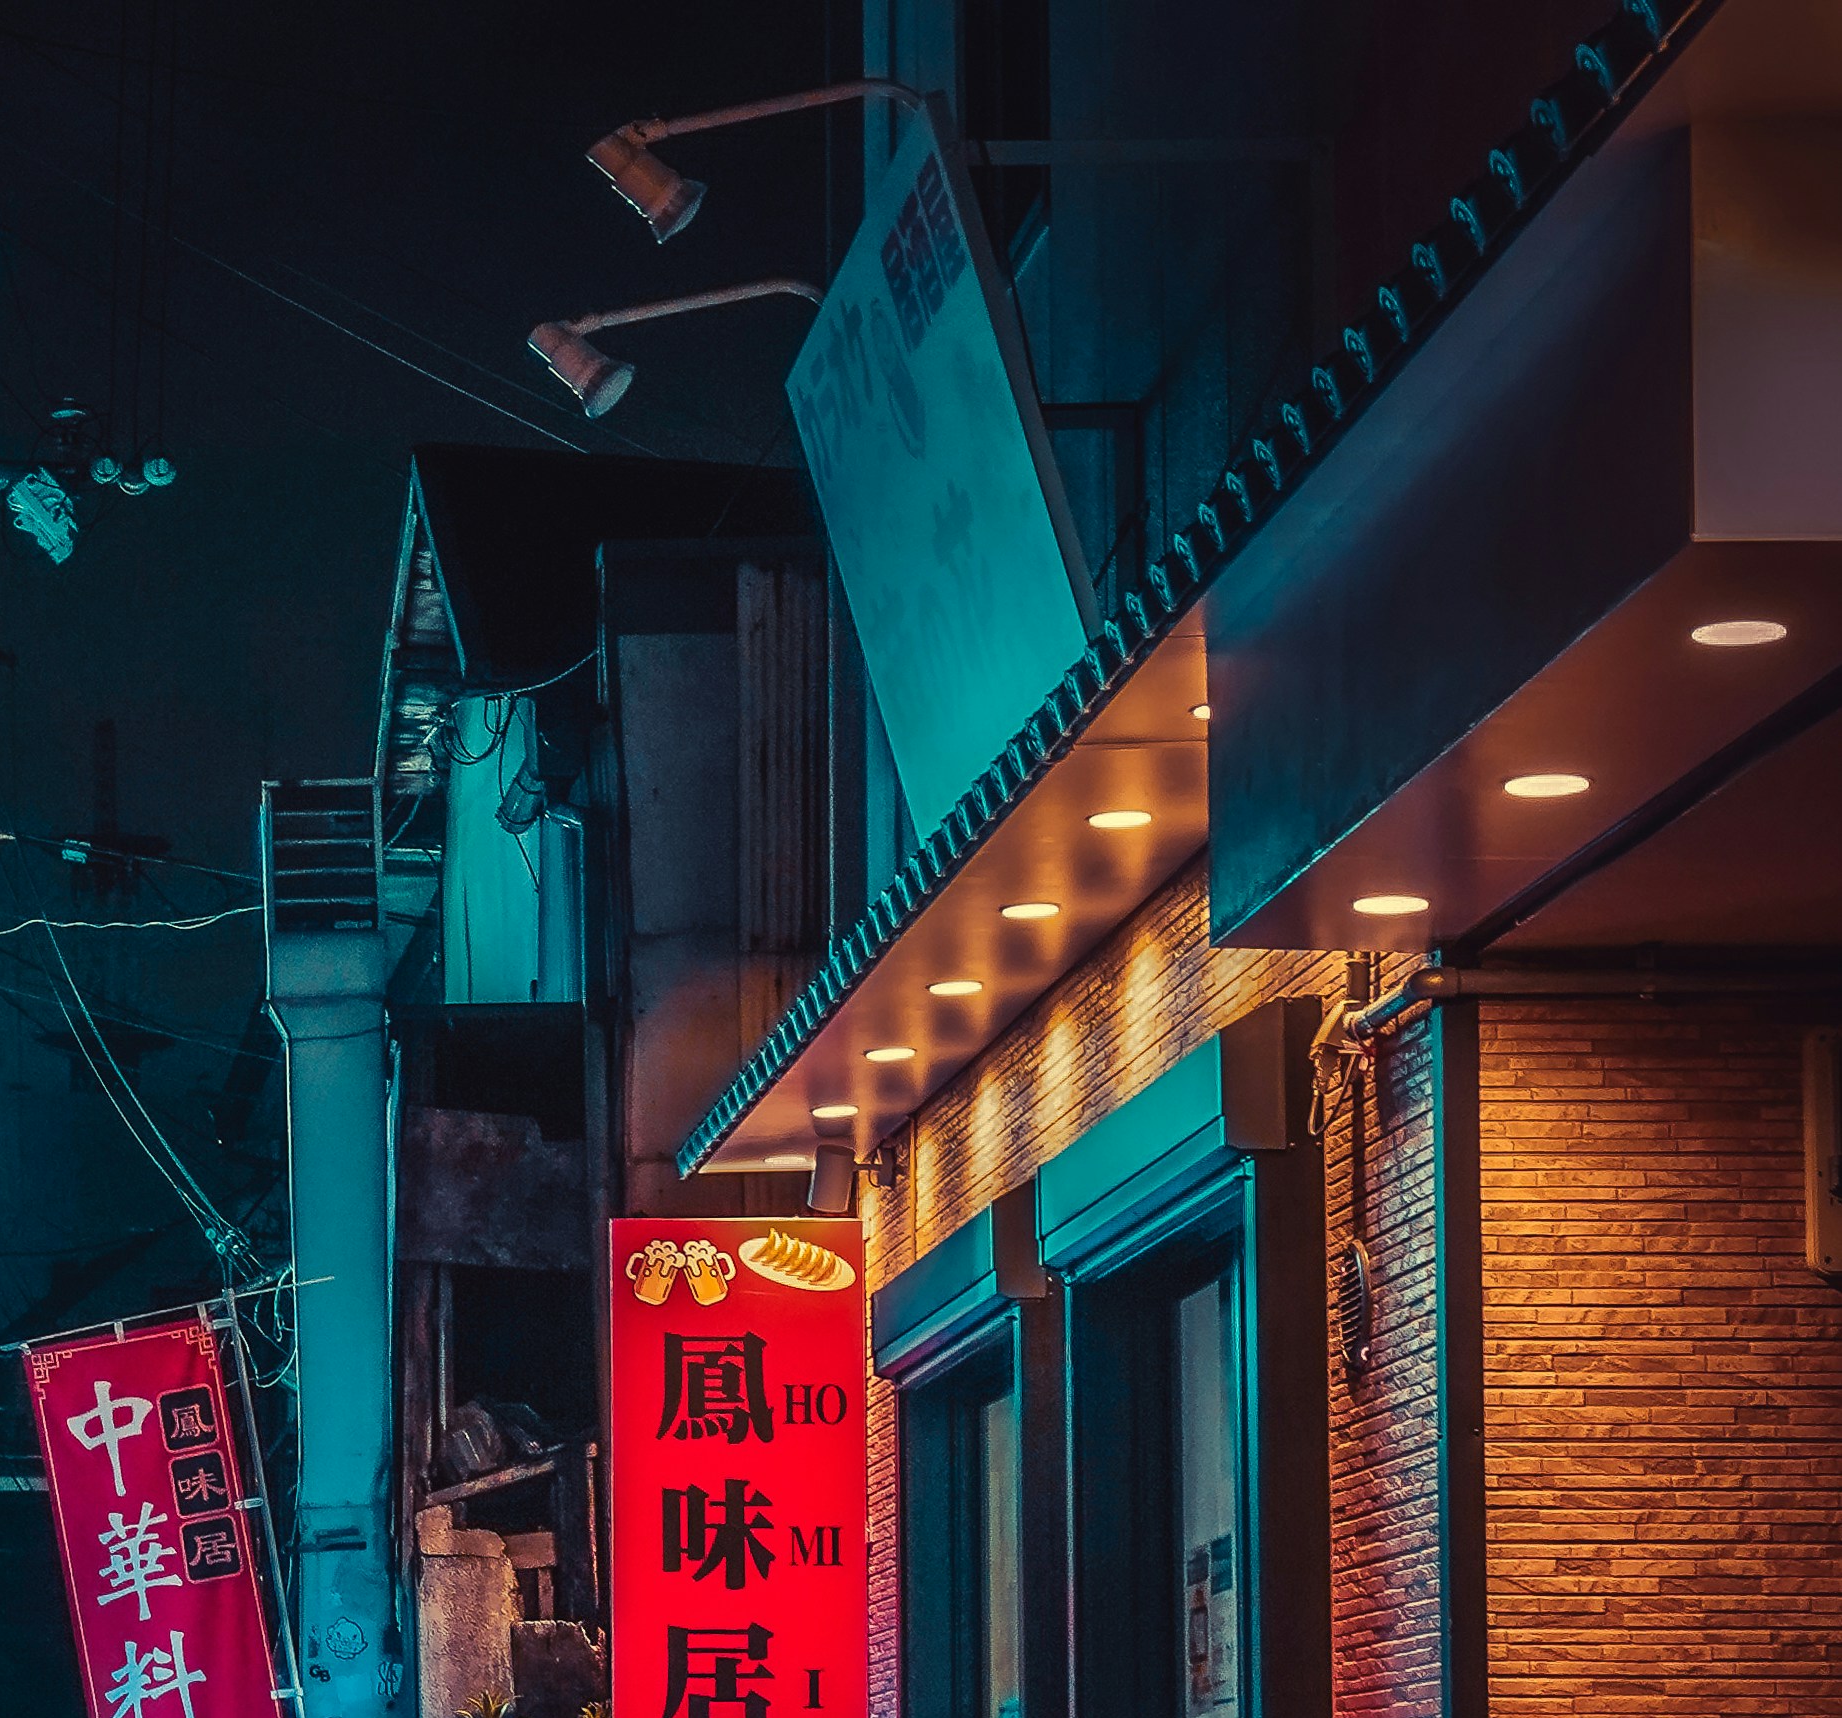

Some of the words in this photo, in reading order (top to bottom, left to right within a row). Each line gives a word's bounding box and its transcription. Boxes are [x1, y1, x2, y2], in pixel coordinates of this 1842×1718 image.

[782, 1382, 848, 1426] HO
[169, 1400, 237, 1567] 鳳味居
[790, 1525, 843, 1567] MI
[804, 1668, 825, 1710] I
